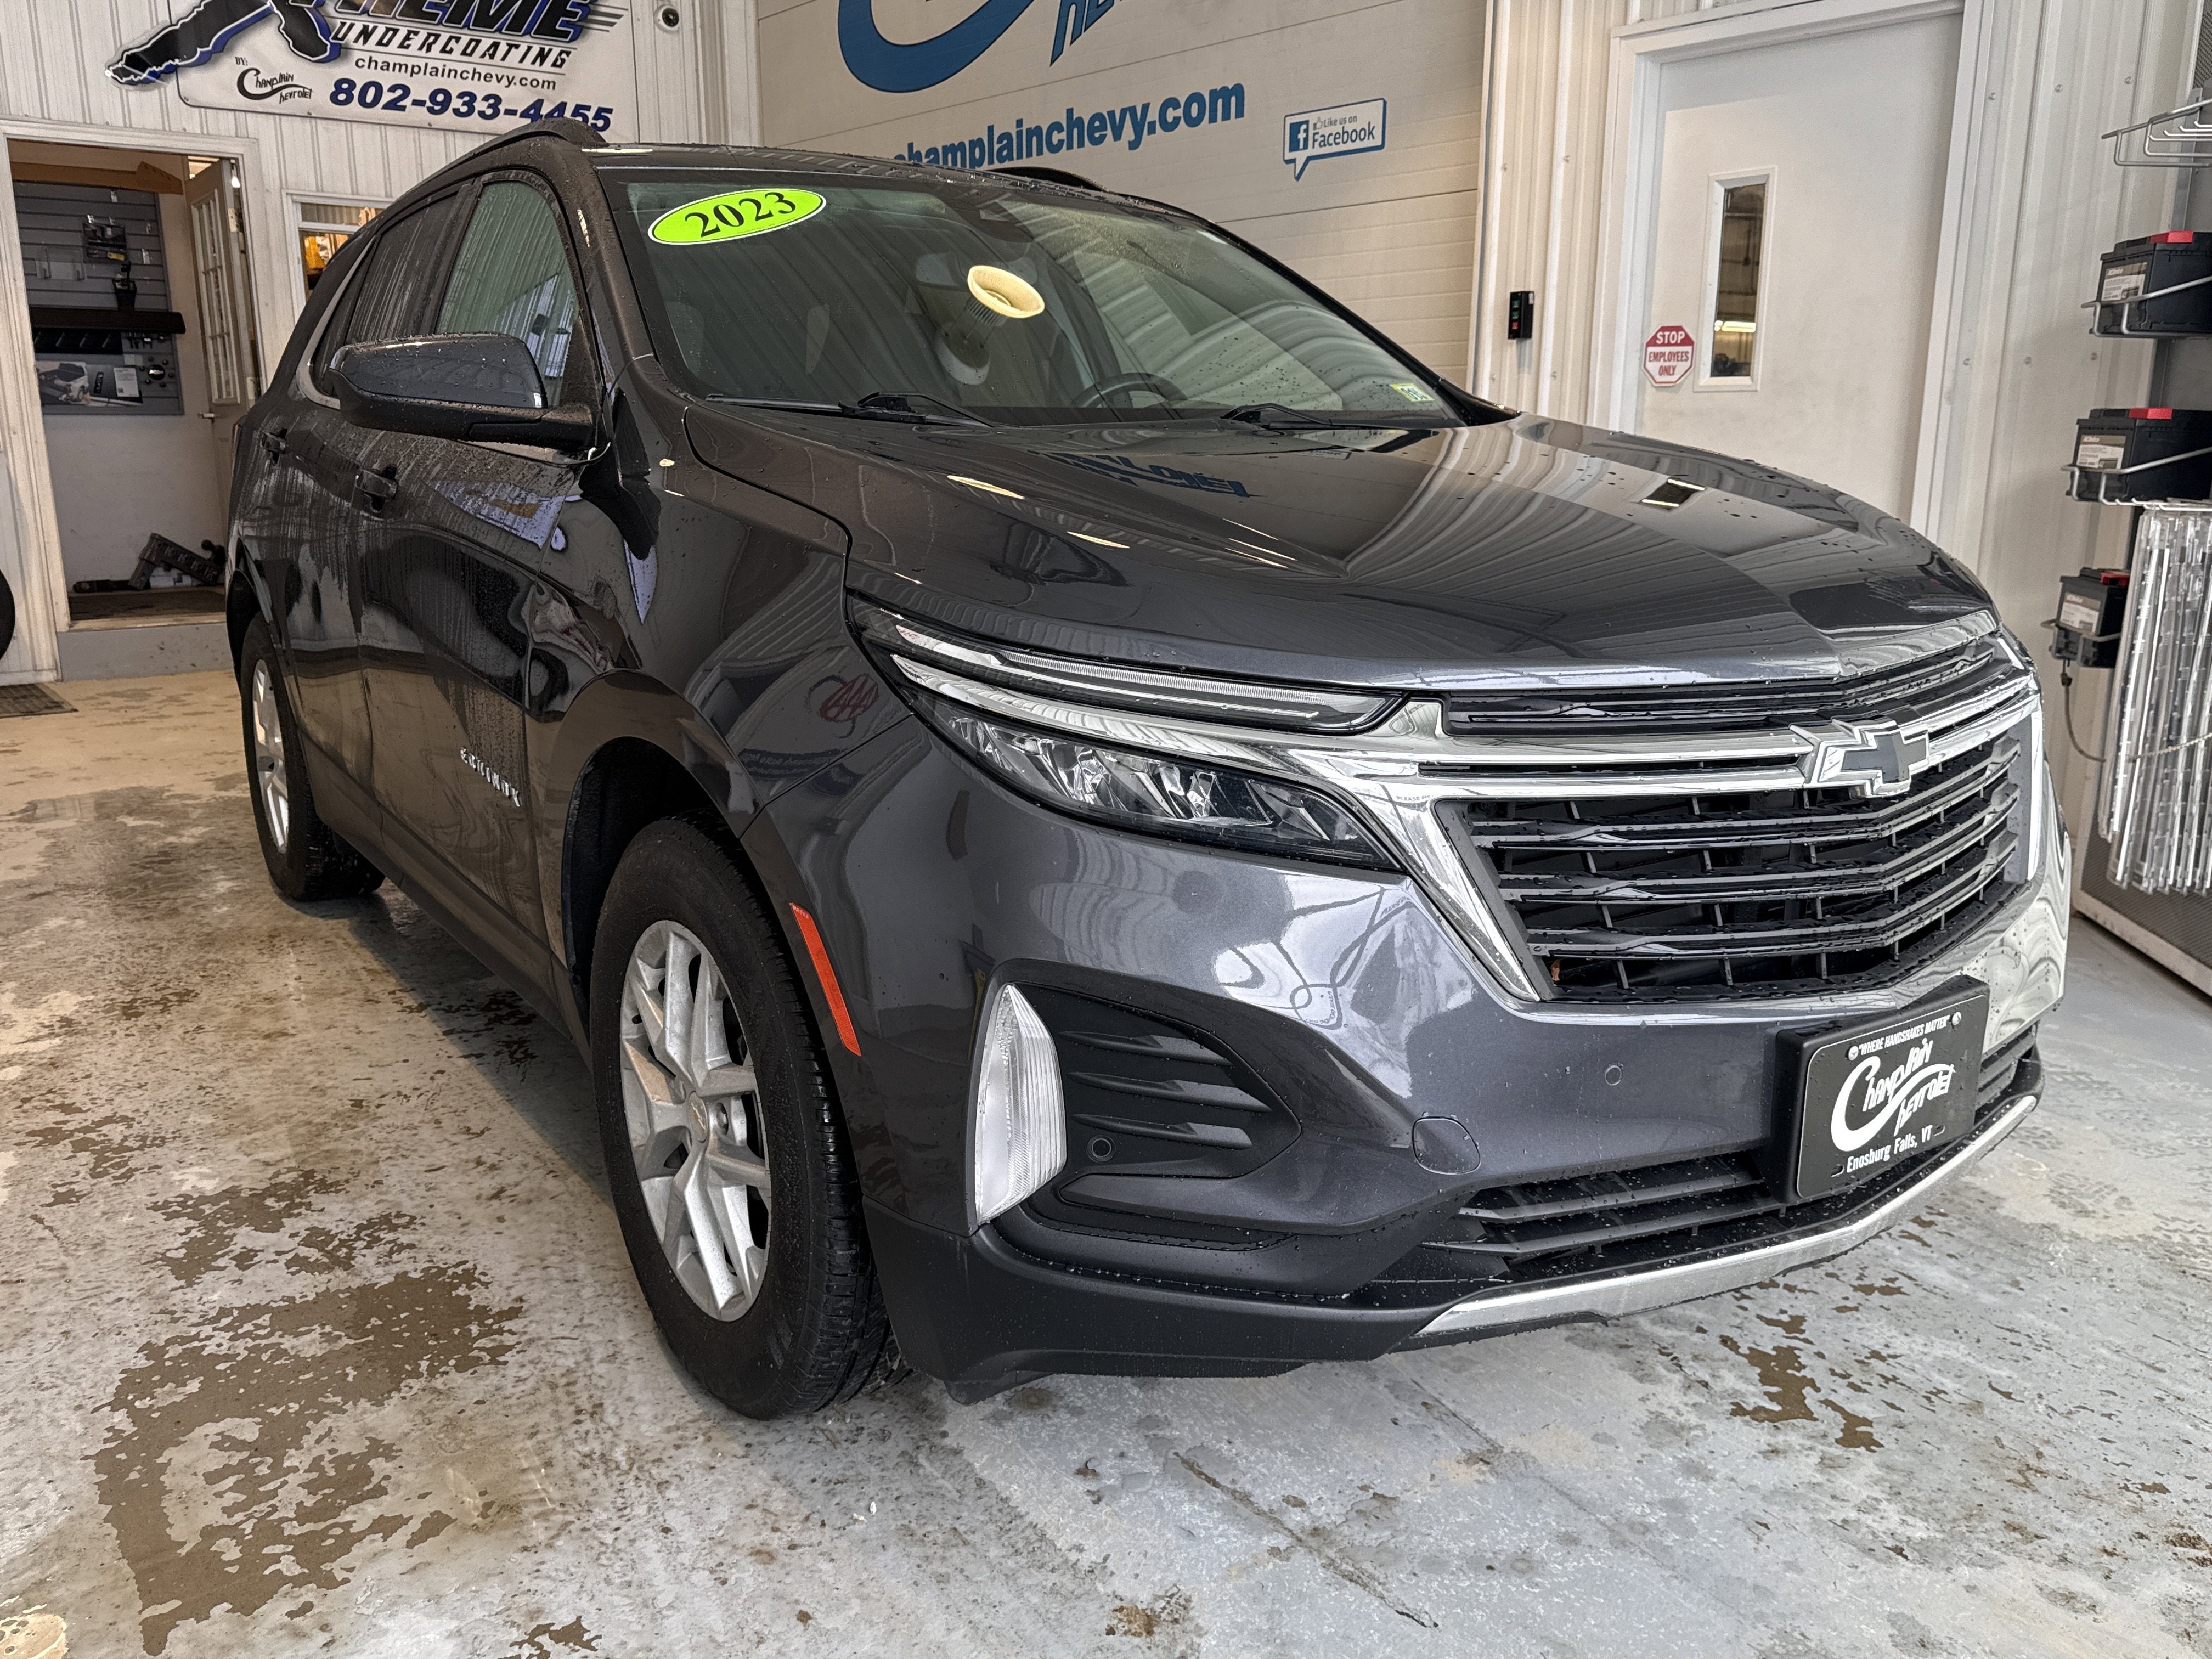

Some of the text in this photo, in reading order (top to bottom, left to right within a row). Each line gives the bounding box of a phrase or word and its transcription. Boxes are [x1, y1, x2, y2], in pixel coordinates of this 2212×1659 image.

[330, 21, 572, 69] UNDERCOATING
[235, 56, 249, 66] BY:
[354, 55, 557, 91] champlainchevy.com
[329, 78, 613, 132] 802-933-4455
[894, 81, 1246, 171] hamplainchevy.com
[1312, 121, 1376, 149] Facebook
[1323, 115, 1357, 128] Like us on
[685, 192, 796, 238] 2023
[1656, 331, 1686, 345] STOP
[1648, 351, 1689, 363] EMPLOYEES
[1658, 365, 1677, 376] ONLY
[1884, 1024, 1925, 1048] HANDSHAKES
[1846, 1124, 1933, 1173] Enosburg Falls, VT
